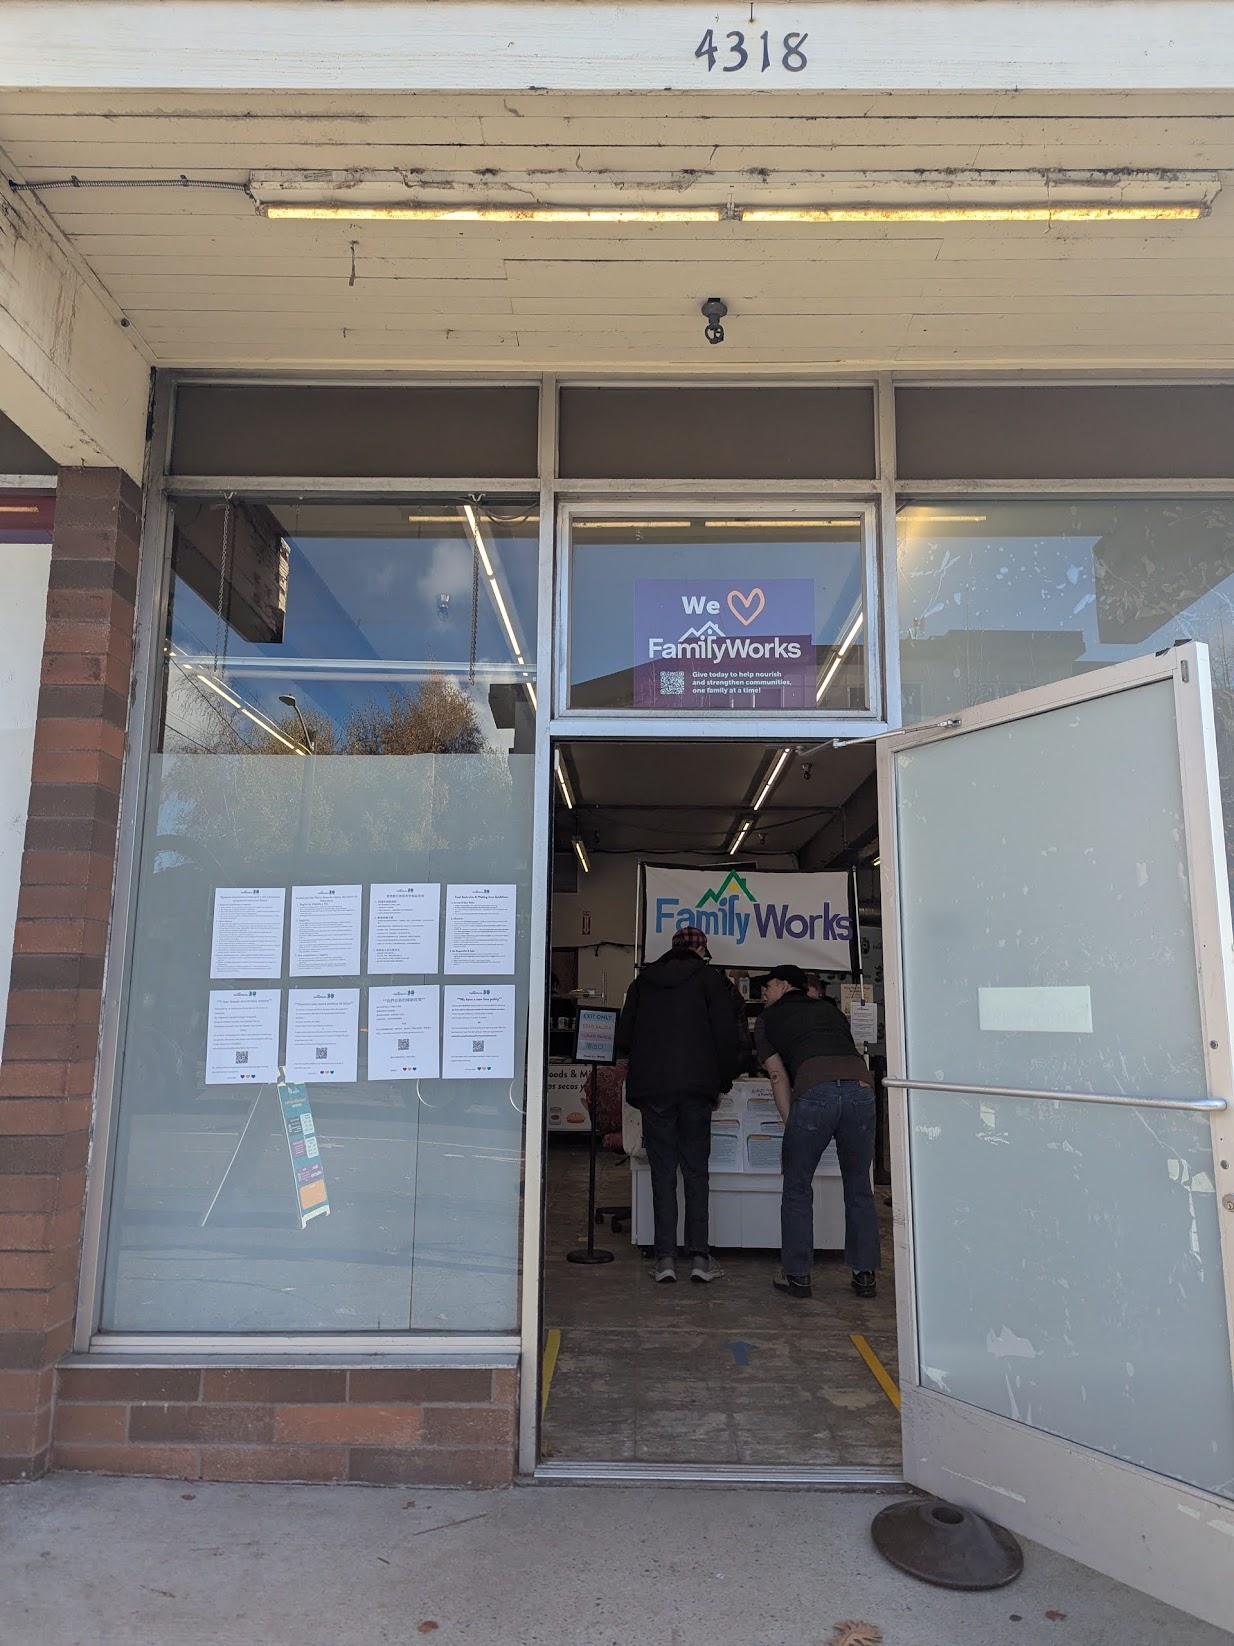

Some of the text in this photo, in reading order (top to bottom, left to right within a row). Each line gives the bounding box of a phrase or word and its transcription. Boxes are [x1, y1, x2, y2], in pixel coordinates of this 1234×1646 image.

[694, 28, 809, 73] 4318
[681, 596, 720, 615] We
[648, 635, 802, 664] FamilyWorks
[709, 671, 728, 679] today
[738, 671, 754, 679] help
[707, 679, 745, 687] strengthen
[706, 687, 728, 695] family
[548, 1069, 568, 1078] oods
[570, 1069, 578, 1078] &
